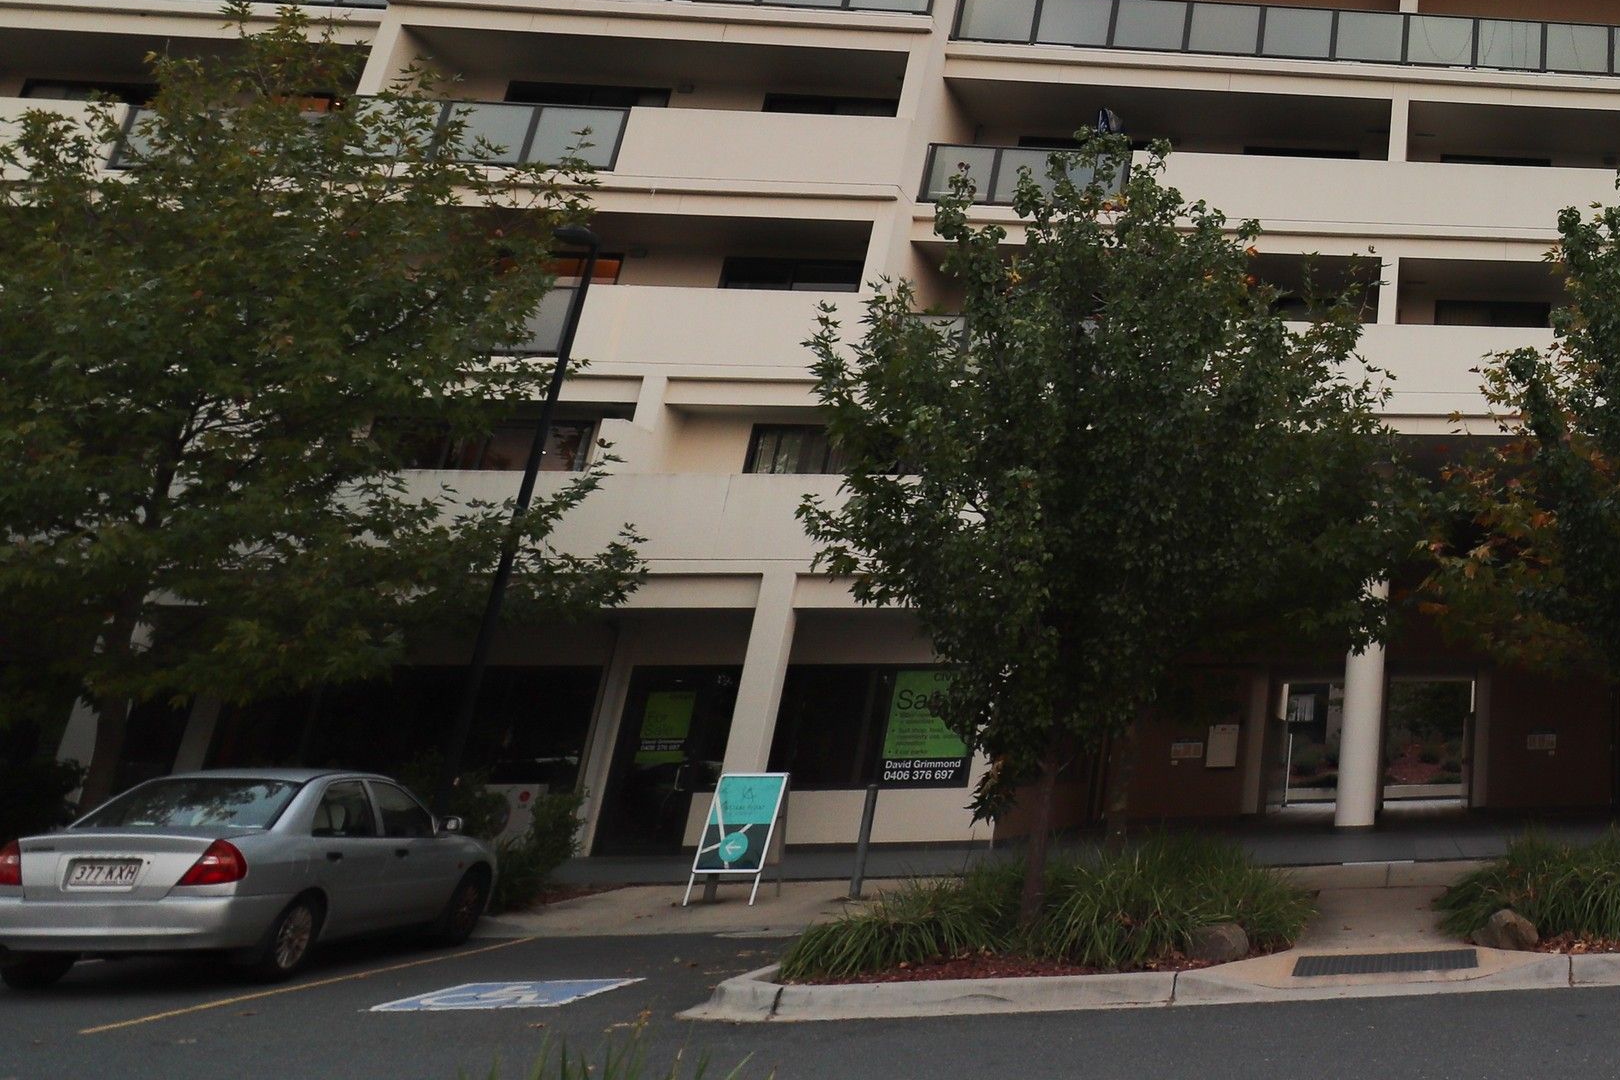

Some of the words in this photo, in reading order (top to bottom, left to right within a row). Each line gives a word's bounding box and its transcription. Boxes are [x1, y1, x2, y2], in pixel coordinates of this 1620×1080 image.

[885, 759, 911, 769] David
[913, 759, 961, 768] Grimmond
[883, 770, 910, 781] 0406
[912, 770, 932, 780] 376
[934, 769, 954, 780] 697
